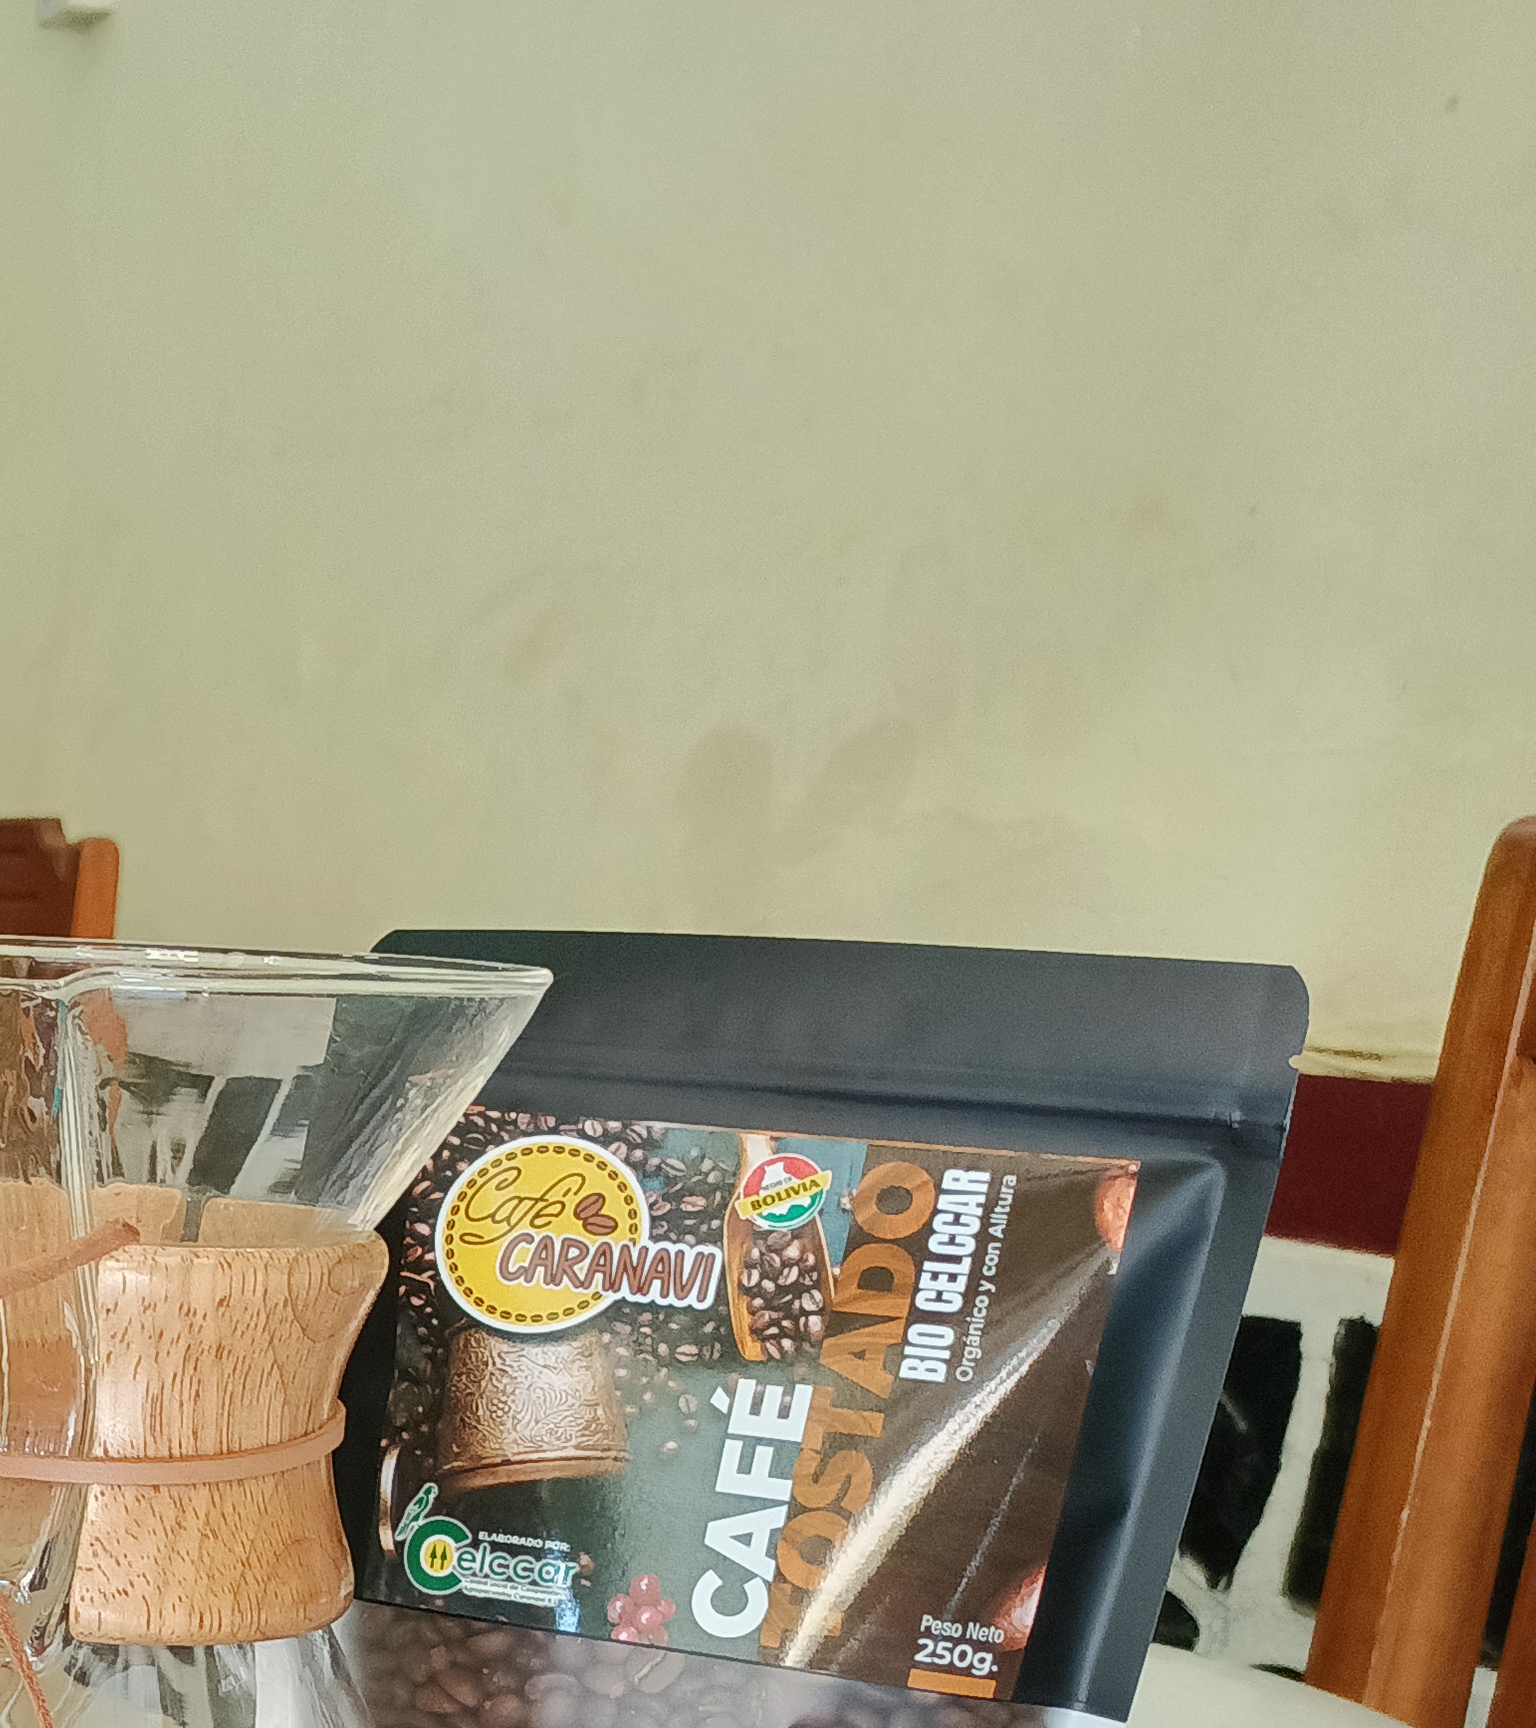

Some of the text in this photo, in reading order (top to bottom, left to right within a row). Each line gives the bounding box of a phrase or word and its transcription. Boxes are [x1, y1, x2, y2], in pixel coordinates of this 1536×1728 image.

[459, 1166, 586, 1246] Café
[750, 1179, 821, 1212] BOLIVIA
[499, 1232, 717, 1302] CARANAVI
[899, 1168, 991, 1383] BIO CELCCAR
[978, 1280, 996, 1293] y
[982, 1242, 1002, 1277] con
[955, 1295, 989, 1382] Orgánico
[759, 1161, 936, 1659] TOSTADO
[691, 1377, 814, 1639] CAFÉ
[478, 1531, 572, 1553] ELABORADO POR:
[920, 1614, 1005, 1644] Peso Neto
[914, 1638, 999, 1676] 250g.
